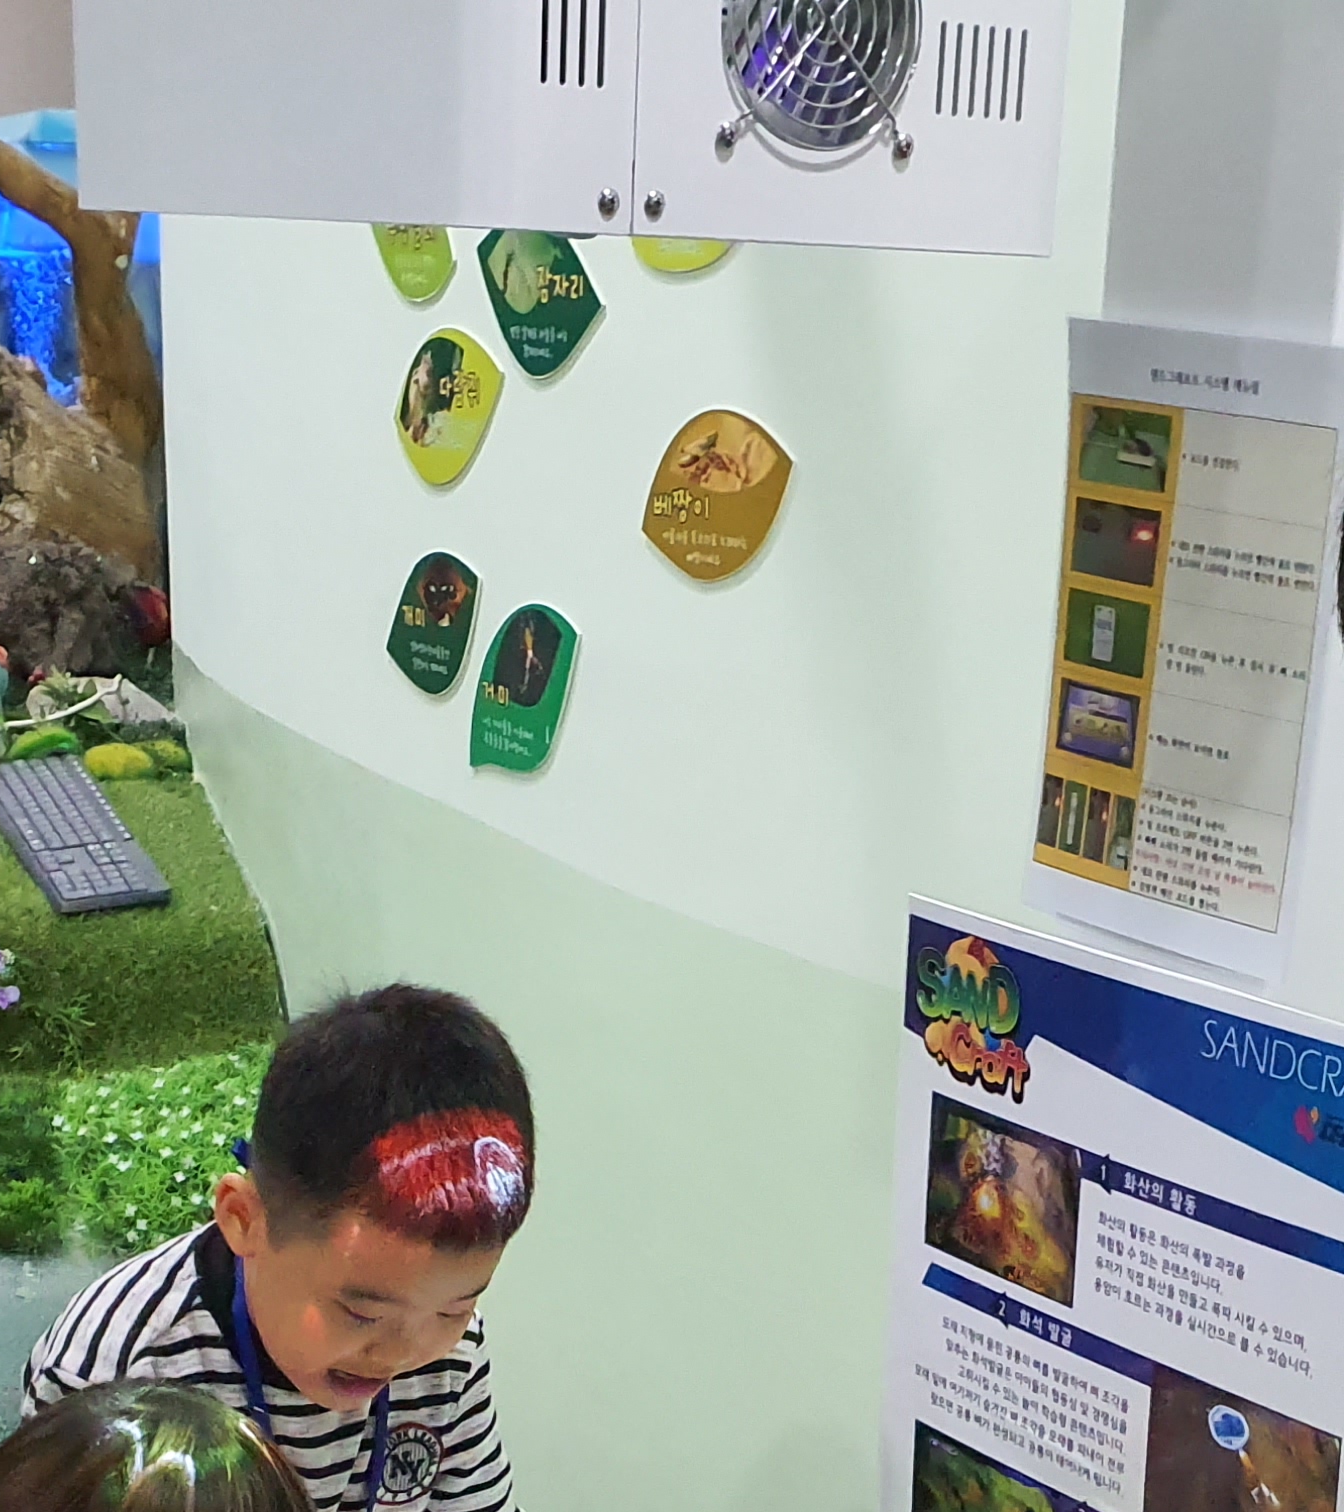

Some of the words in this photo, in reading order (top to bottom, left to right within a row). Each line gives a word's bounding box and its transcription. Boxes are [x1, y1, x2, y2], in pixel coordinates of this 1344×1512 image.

[537, 265, 584, 304] 잠자리
[439, 370, 480, 408] 다람쥐
[653, 488, 709, 523] 베짱이
[402, 605, 425, 628] 개미
[482, 681, 509, 707] 거미
[916, 946, 1020, 1035] SAND
[1101, 1164, 1106, 1180] 1
[1123, 1171, 1164, 1203] 화산의
[1169, 1188, 1198, 1215] 활동
[1099, 1211, 1126, 1233] 화산의
[1129, 1223, 1156, 1246] 활동은
[1160, 1235, 1189, 1258] 화산의
[1215, 1257, 1245, 1280] 과정을
[1127, 1246, 1136, 1260] 수
[1139, 1249, 1158, 1269] 있는
[1095, 1256, 1123, 1279] 유저가
[1126, 1266, 1144, 1288] 직접
[1147, 1275, 1175, 1300] 화산을
[1179, 1288, 1208, 1312] 만들고
[1235, 1310, 1255, 1332] 시킬
[1259, 1321, 1268, 1335] 수
[1272, 1325, 1307, 1351] 있으며,
[998, 1300, 1005, 1316] 2
[1019, 1309, 1043, 1335] 화석
[1048, 1322, 1073, 1348] 발굴
[1187, 1315, 1236, 1347] 실시간으로
[1253, 1343, 1263, 1357] 수
[1267, 1346, 1313, 1379] 있습니다.
[992, 1382, 1001, 1395] 수
[1003, 1386, 1019, 1405] 있는
